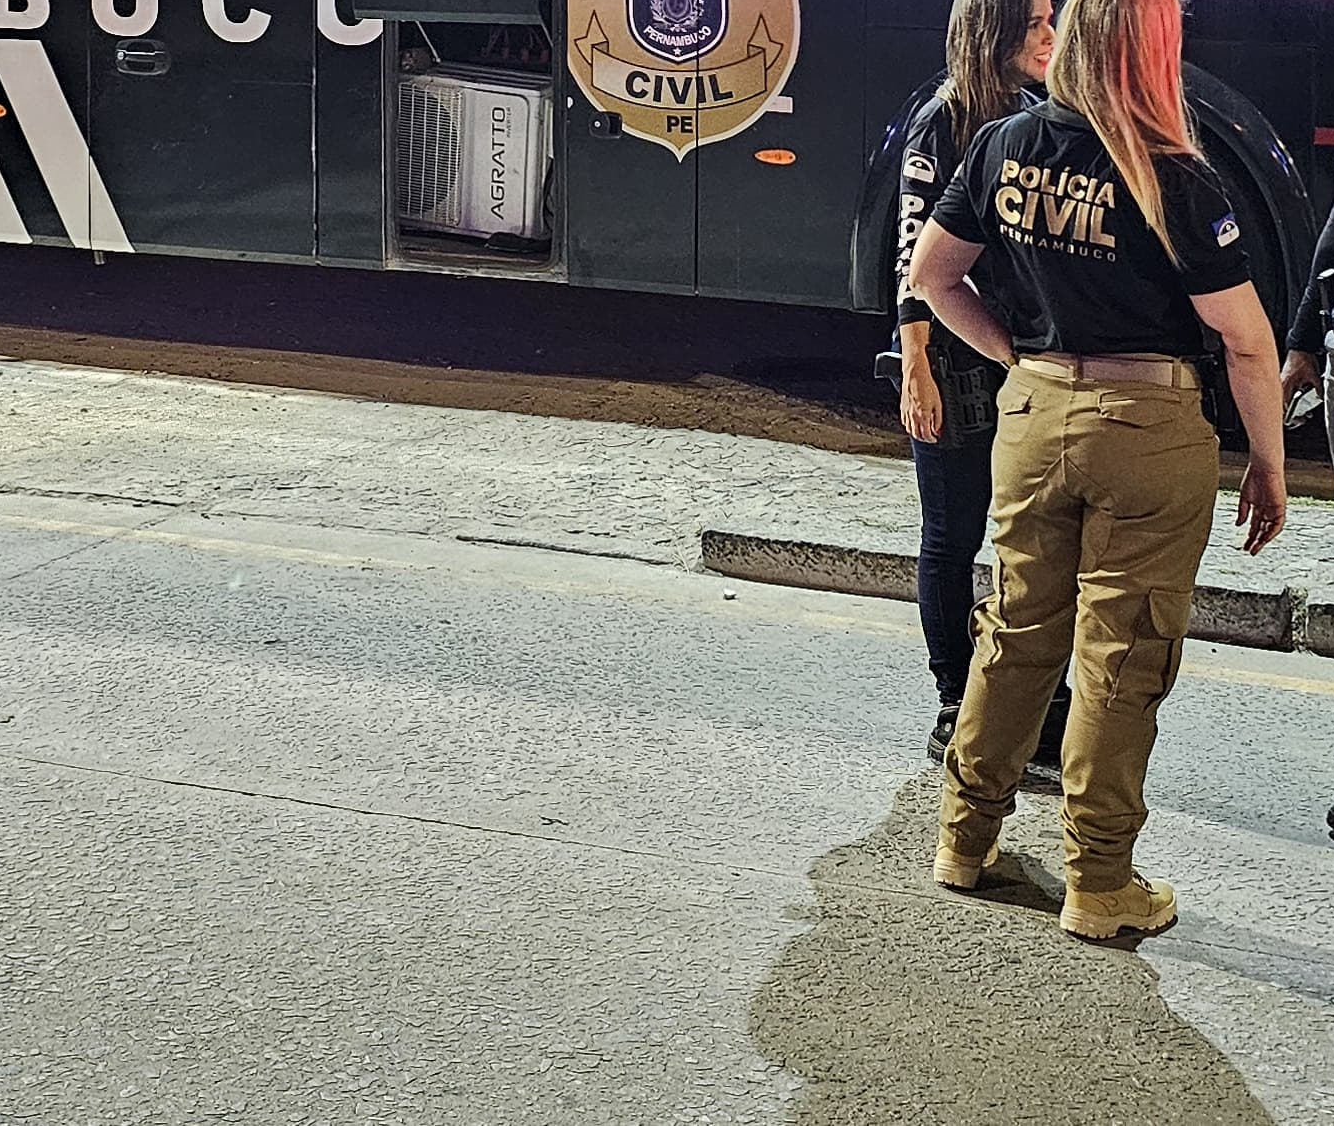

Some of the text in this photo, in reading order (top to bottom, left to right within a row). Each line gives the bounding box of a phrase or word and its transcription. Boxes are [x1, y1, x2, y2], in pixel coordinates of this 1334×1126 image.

[625, 70, 734, 105] CIVIL
[666, 115, 694, 133] PE
[491, 107, 506, 220] AGRATTO
[1000, 158, 1115, 209] POLÍCIA
[994, 185, 1116, 248] CIVIL
